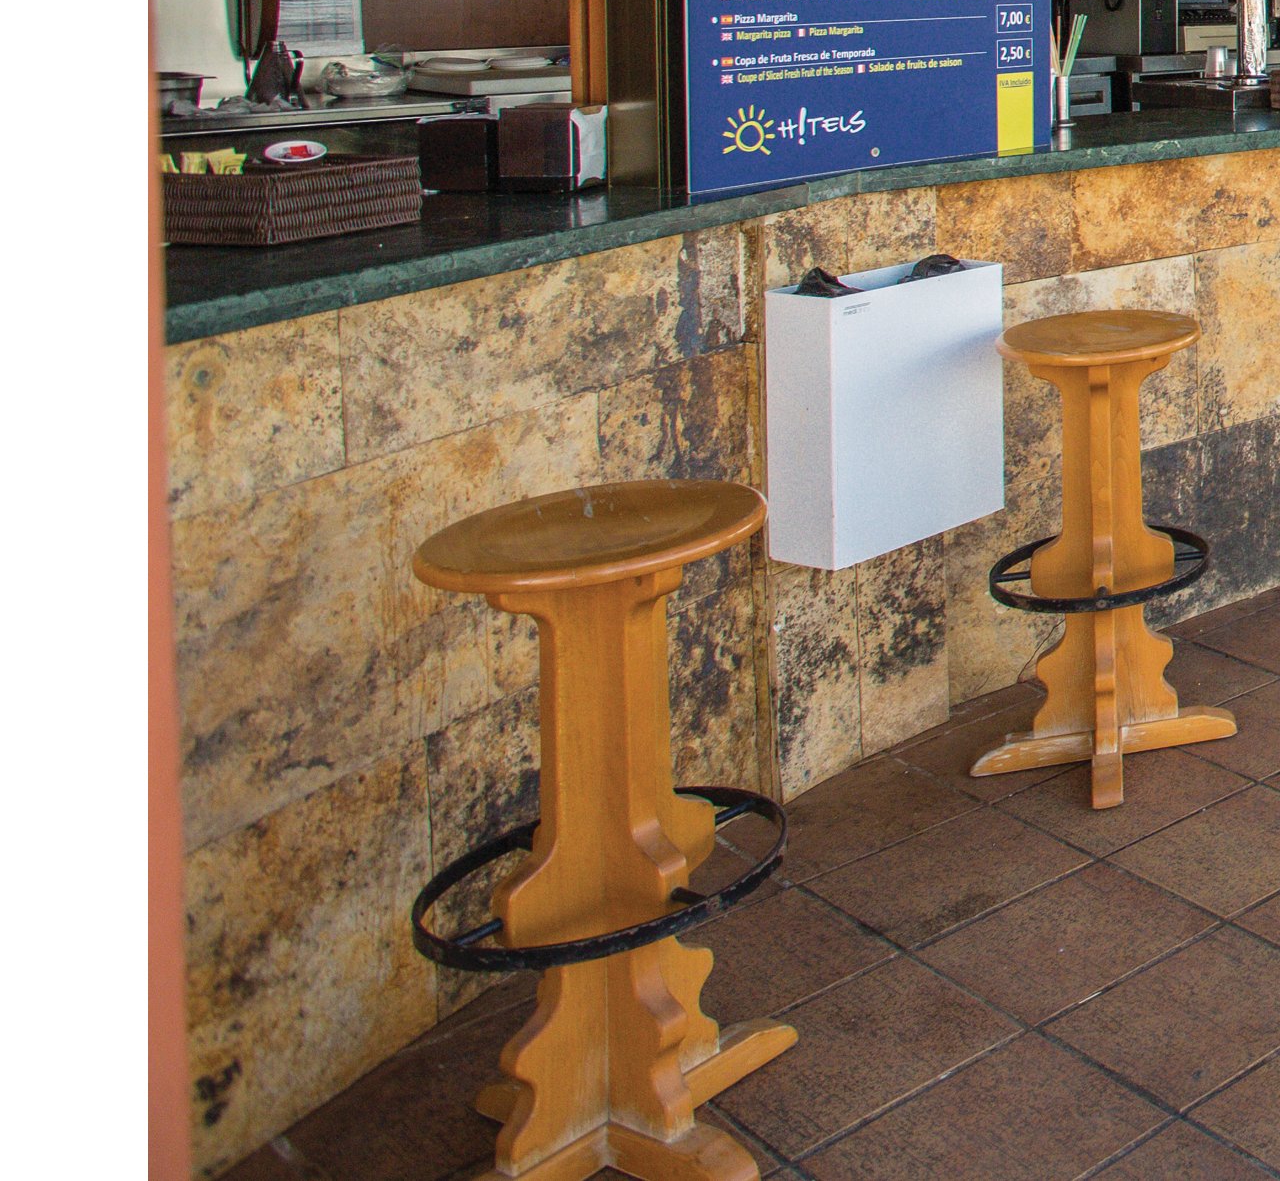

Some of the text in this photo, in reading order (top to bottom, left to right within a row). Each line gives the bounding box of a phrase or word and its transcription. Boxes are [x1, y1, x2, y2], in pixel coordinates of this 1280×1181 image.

[733, 11, 797, 24] Pizza Margarita
[736, 28, 791, 41] Margarita pizza
[808, 24, 863, 36] Pizza Margarita
[734, 47, 875, 67] Copa de Fruta Fresca de Temporada
[868, 57, 962, 72] Salade de fruits de saison
